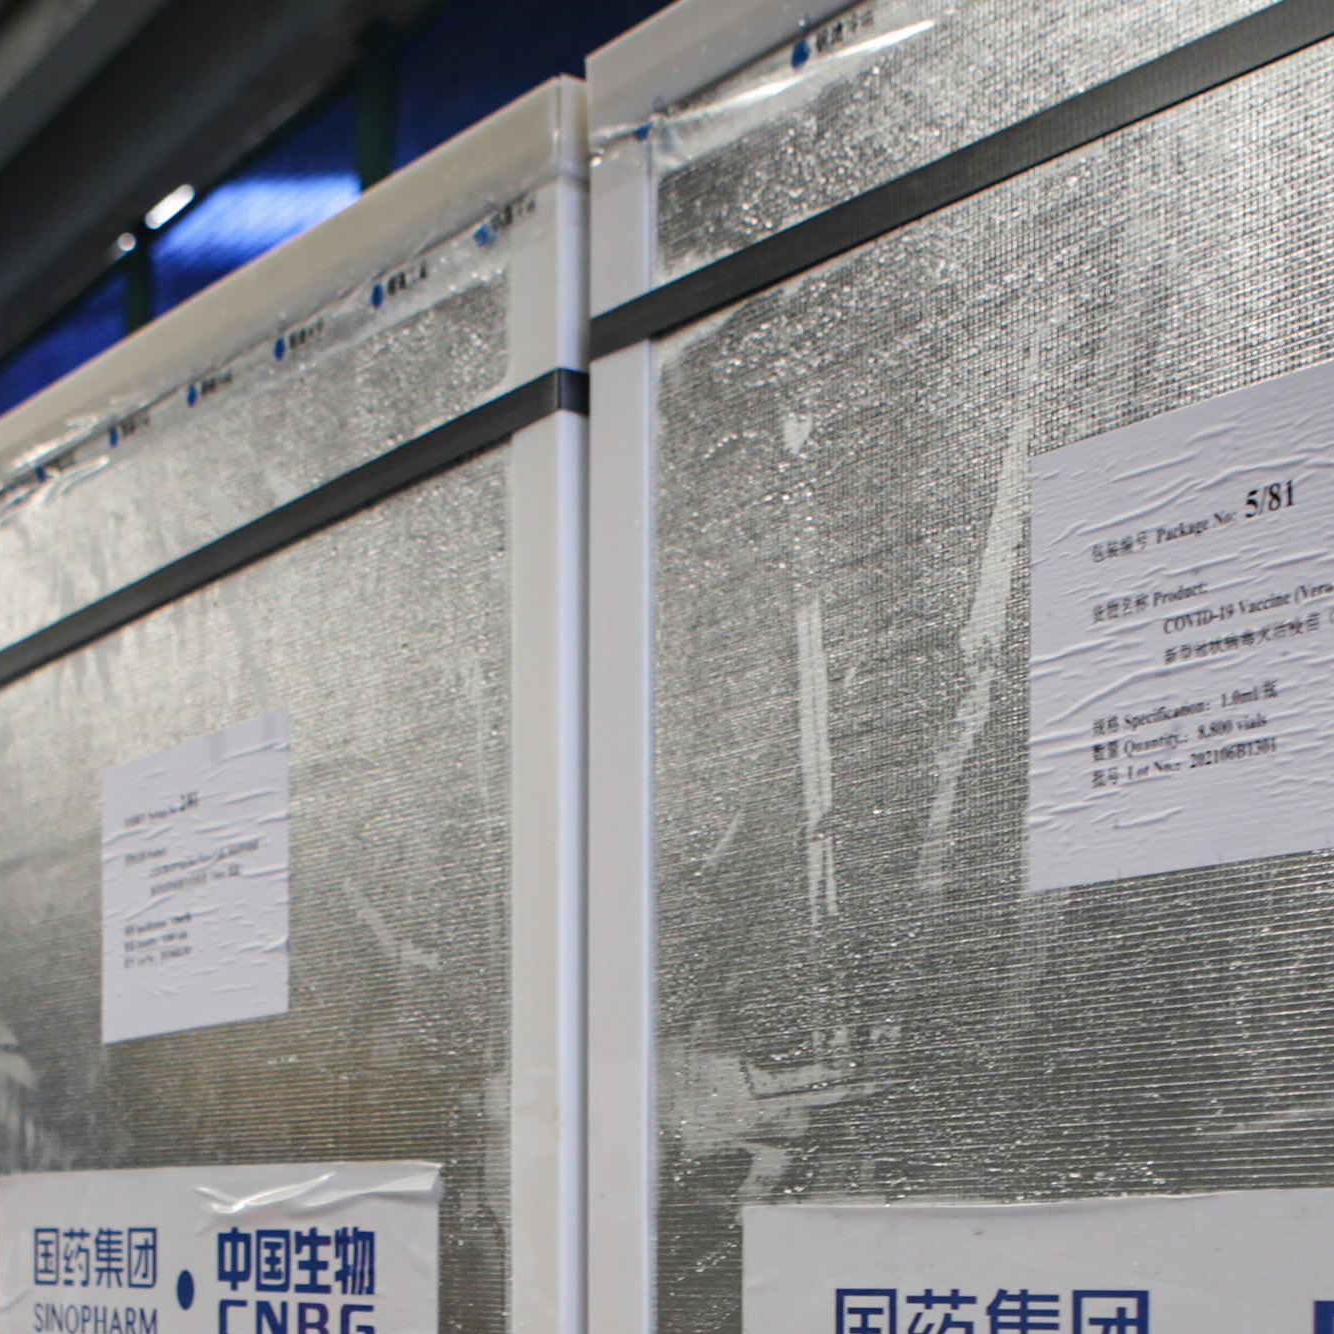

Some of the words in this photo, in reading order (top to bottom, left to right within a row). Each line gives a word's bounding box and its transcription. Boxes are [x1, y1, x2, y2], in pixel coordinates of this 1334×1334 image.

[1155, 518, 1210, 545] Package
[1244, 479, 1295, 519] 5/81
[1152, 581, 1209, 608] Product:
[1163, 602, 1235, 634] COVID-19
[1238, 592, 1291, 615] Vaccine
[33, 1227, 158, 1289] 国药集团
[216, 1226, 376, 1296] 中国生物
